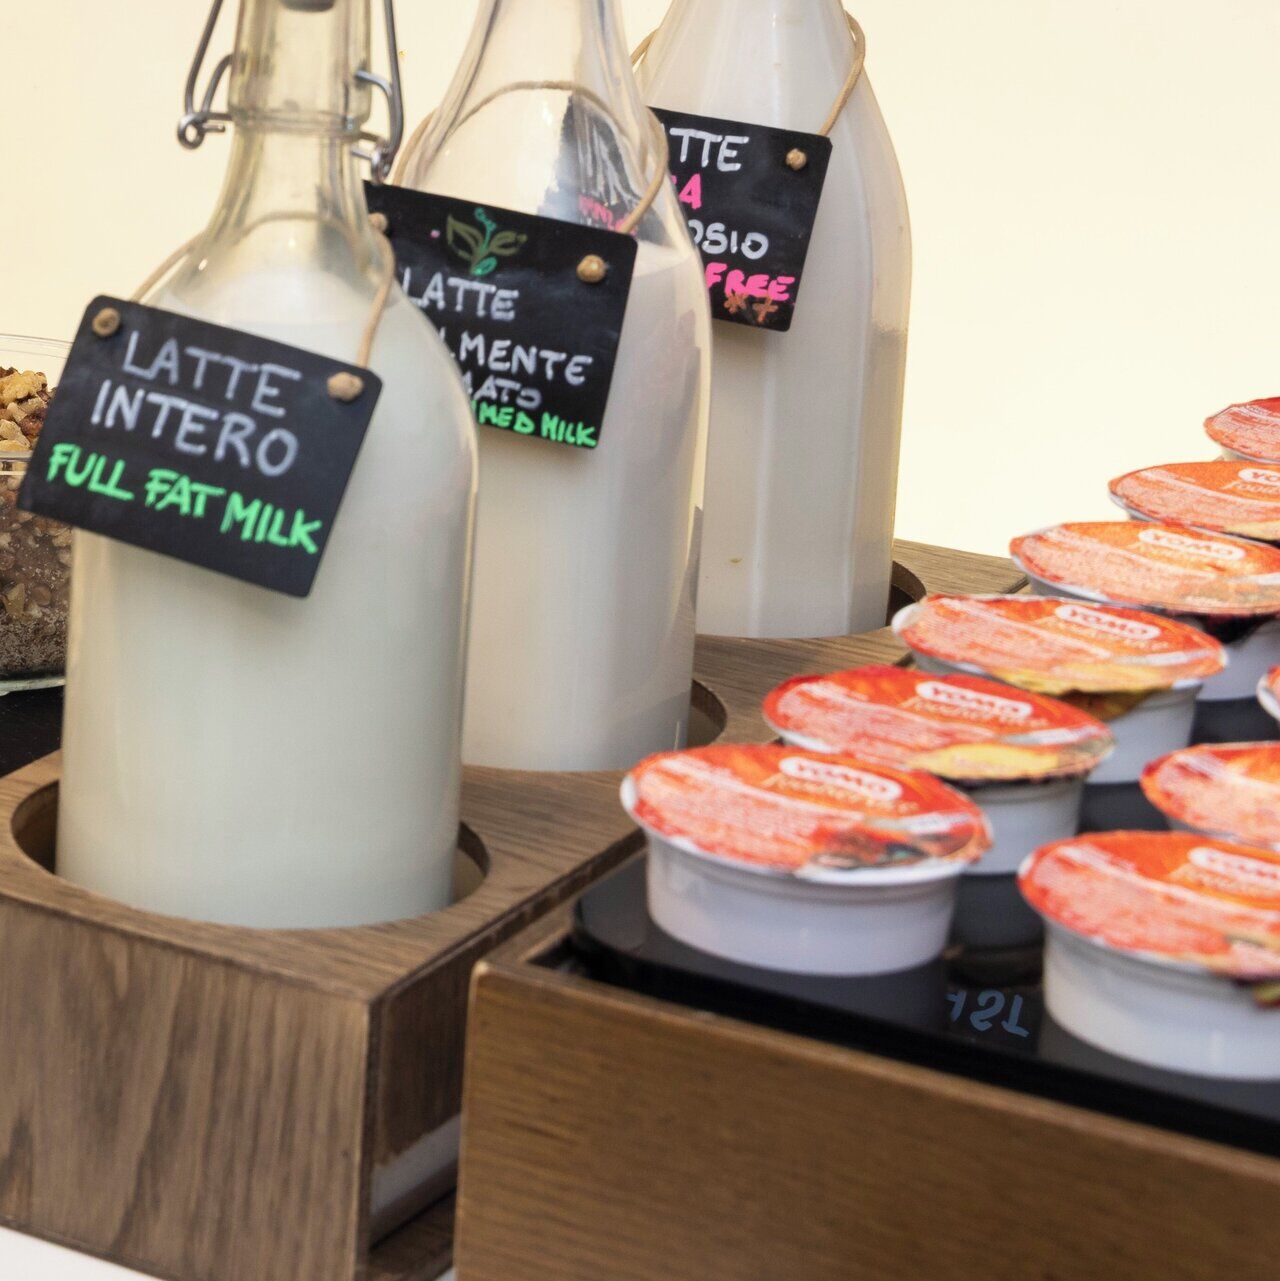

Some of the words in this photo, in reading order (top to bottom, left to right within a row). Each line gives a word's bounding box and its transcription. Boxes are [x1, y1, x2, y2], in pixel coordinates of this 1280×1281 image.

[661, 123, 749, 172] TTE
[402, 267, 519, 320] LATTE
[122, 330, 302, 418] LATTE
[443, 327, 594, 386] MENTE
[90, 379, 300, 477] INTERO
[541, 411, 598, 448] MILK
[46, 443, 135, 501] FULL
[144, 468, 226, 518] FAT
[220, 491, 323, 555] MILK
